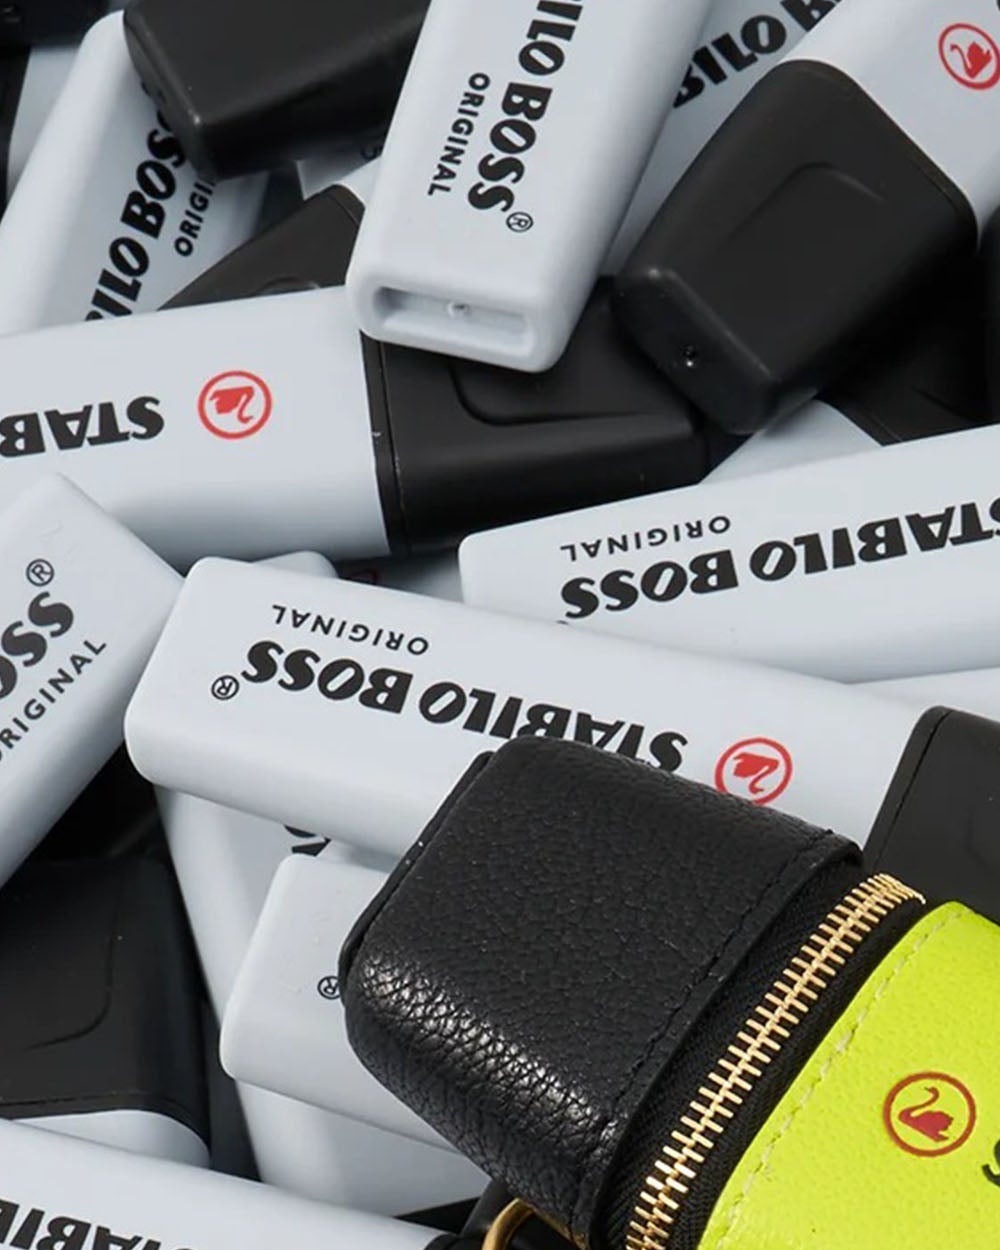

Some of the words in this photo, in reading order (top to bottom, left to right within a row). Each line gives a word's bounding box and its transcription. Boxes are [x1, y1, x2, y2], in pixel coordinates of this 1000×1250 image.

[120, 109, 187, 239] BOS
[427, 72, 491, 196] ORIGINAL
[559, 514, 731, 562] ORIGINAL
[271, 603, 430, 657] ORIGINAL
[0, 639, 107, 762] RIGINAL
